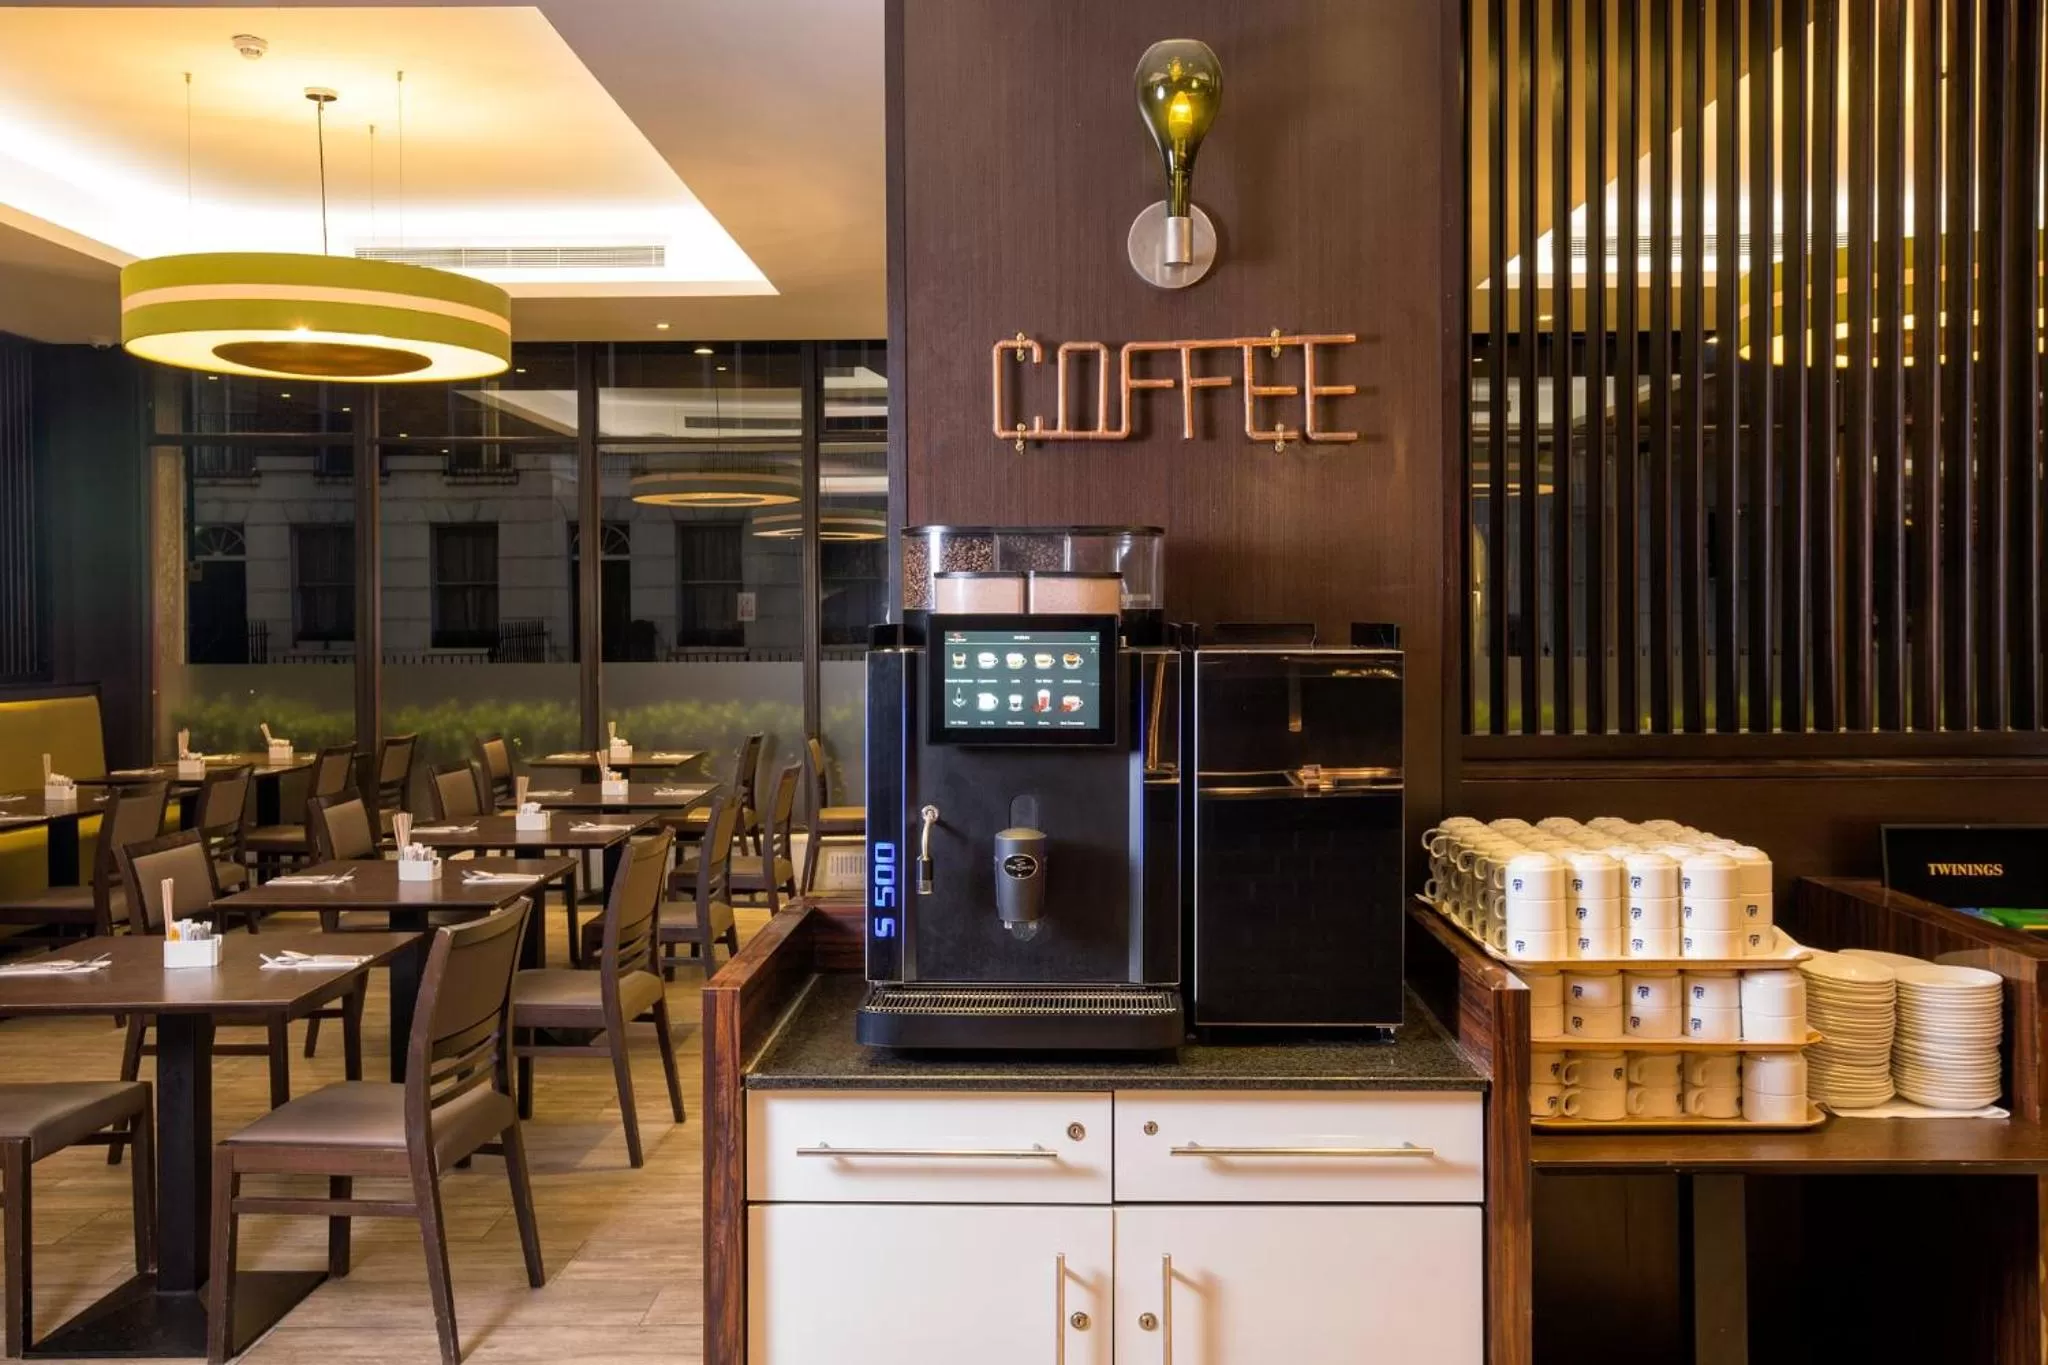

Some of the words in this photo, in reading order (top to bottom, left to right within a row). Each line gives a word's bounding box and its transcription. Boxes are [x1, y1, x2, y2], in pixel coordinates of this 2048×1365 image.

[993, 332, 1358, 441] COFFEE
[875, 843, 895, 907] 500
[1927, 863, 2004, 876] TWININGS
[875, 917, 895, 937] S
